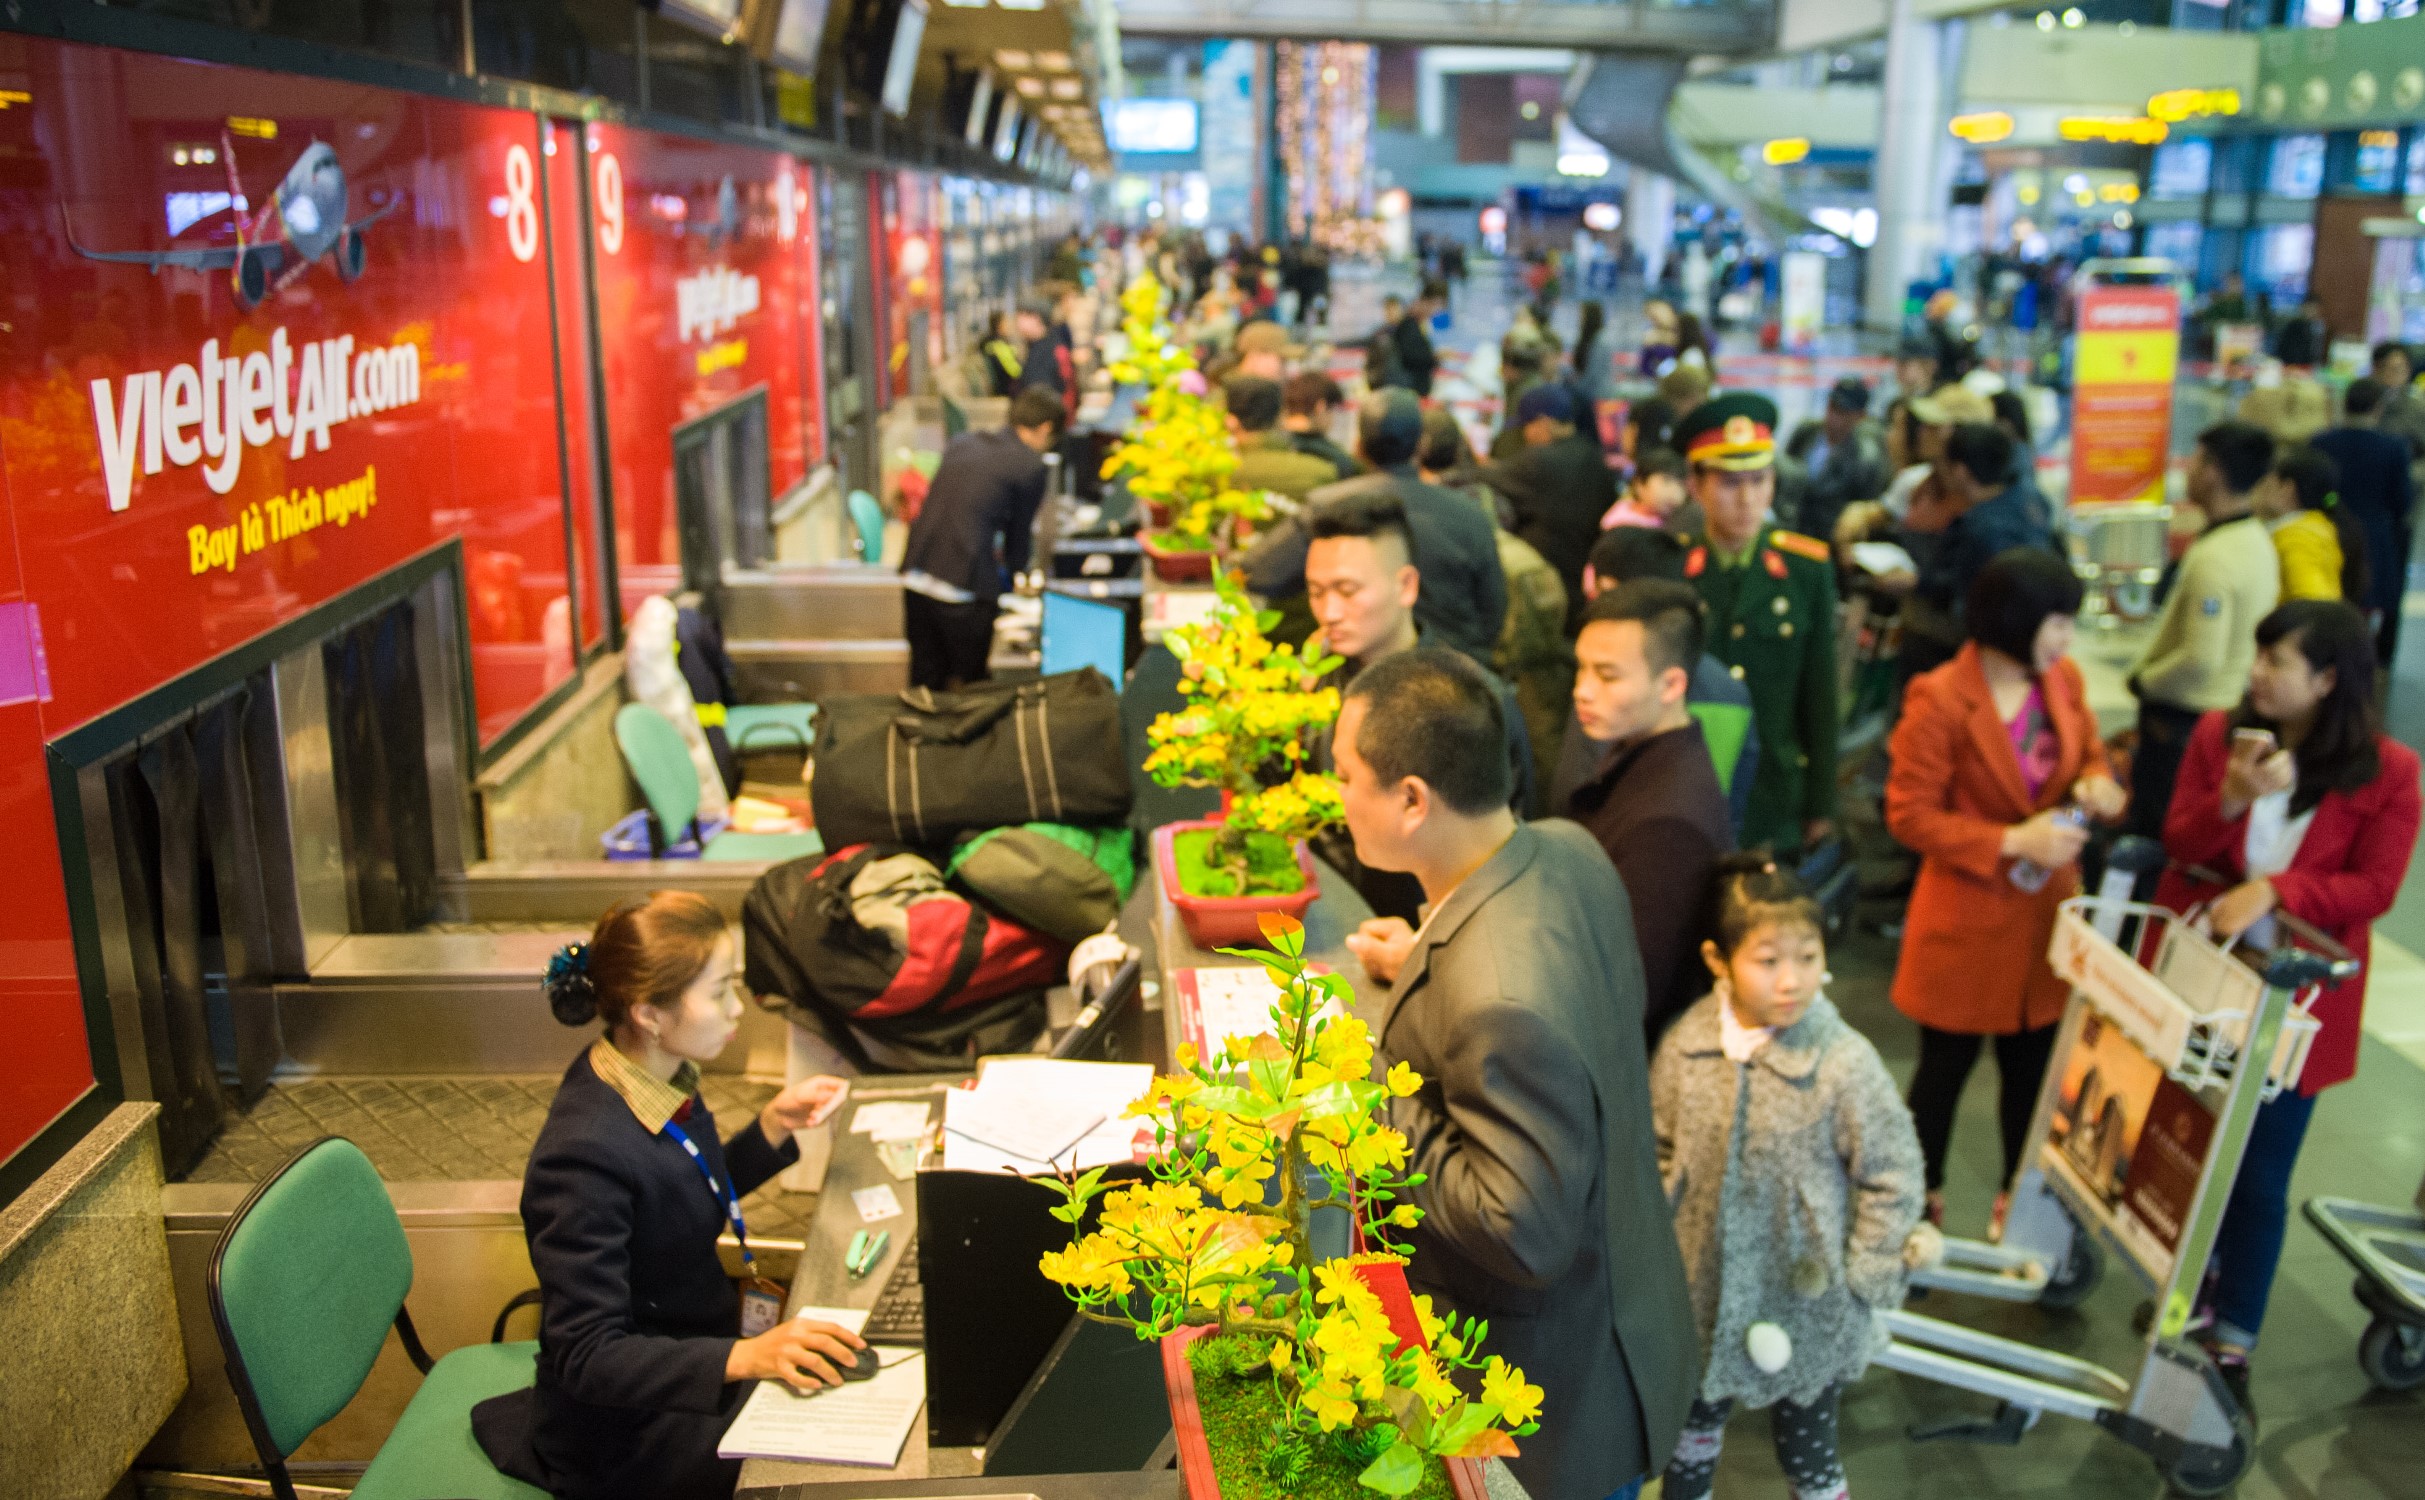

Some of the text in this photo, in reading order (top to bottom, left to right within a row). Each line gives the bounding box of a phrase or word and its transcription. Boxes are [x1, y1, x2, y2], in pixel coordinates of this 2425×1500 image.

[506, 143, 539, 263] 8
[598, 153, 624, 256] 9
[187, 463, 378, 575] Bay là Thích ngay!
